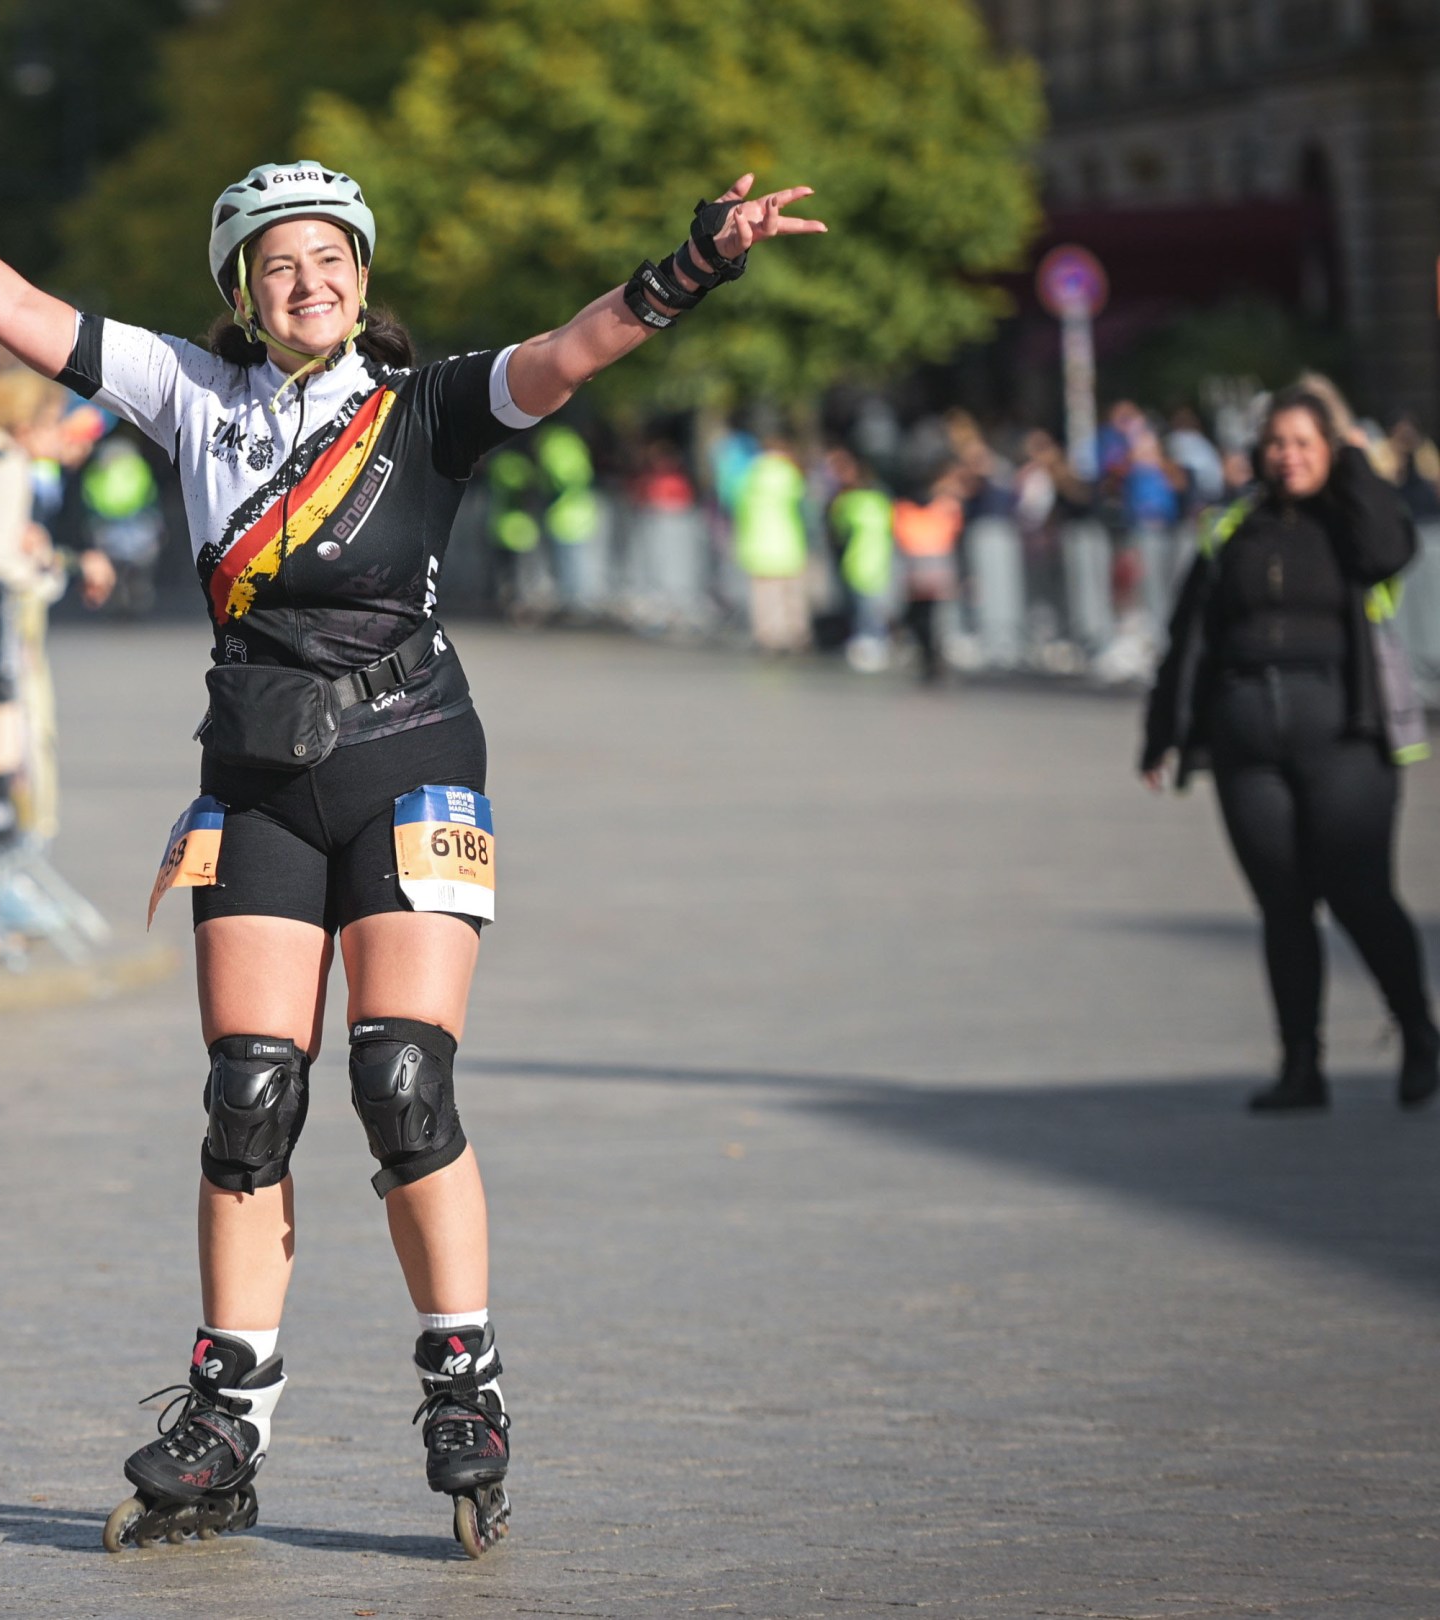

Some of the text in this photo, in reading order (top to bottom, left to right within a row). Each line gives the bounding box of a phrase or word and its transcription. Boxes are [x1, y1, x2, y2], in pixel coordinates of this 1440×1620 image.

[272, 171, 320, 184] 6188
[431, 827, 489, 866] 6188
[459, 865, 476, 878] Emily
[199, 1357, 223, 1380] K2
[440, 1352, 472, 1376] K2
